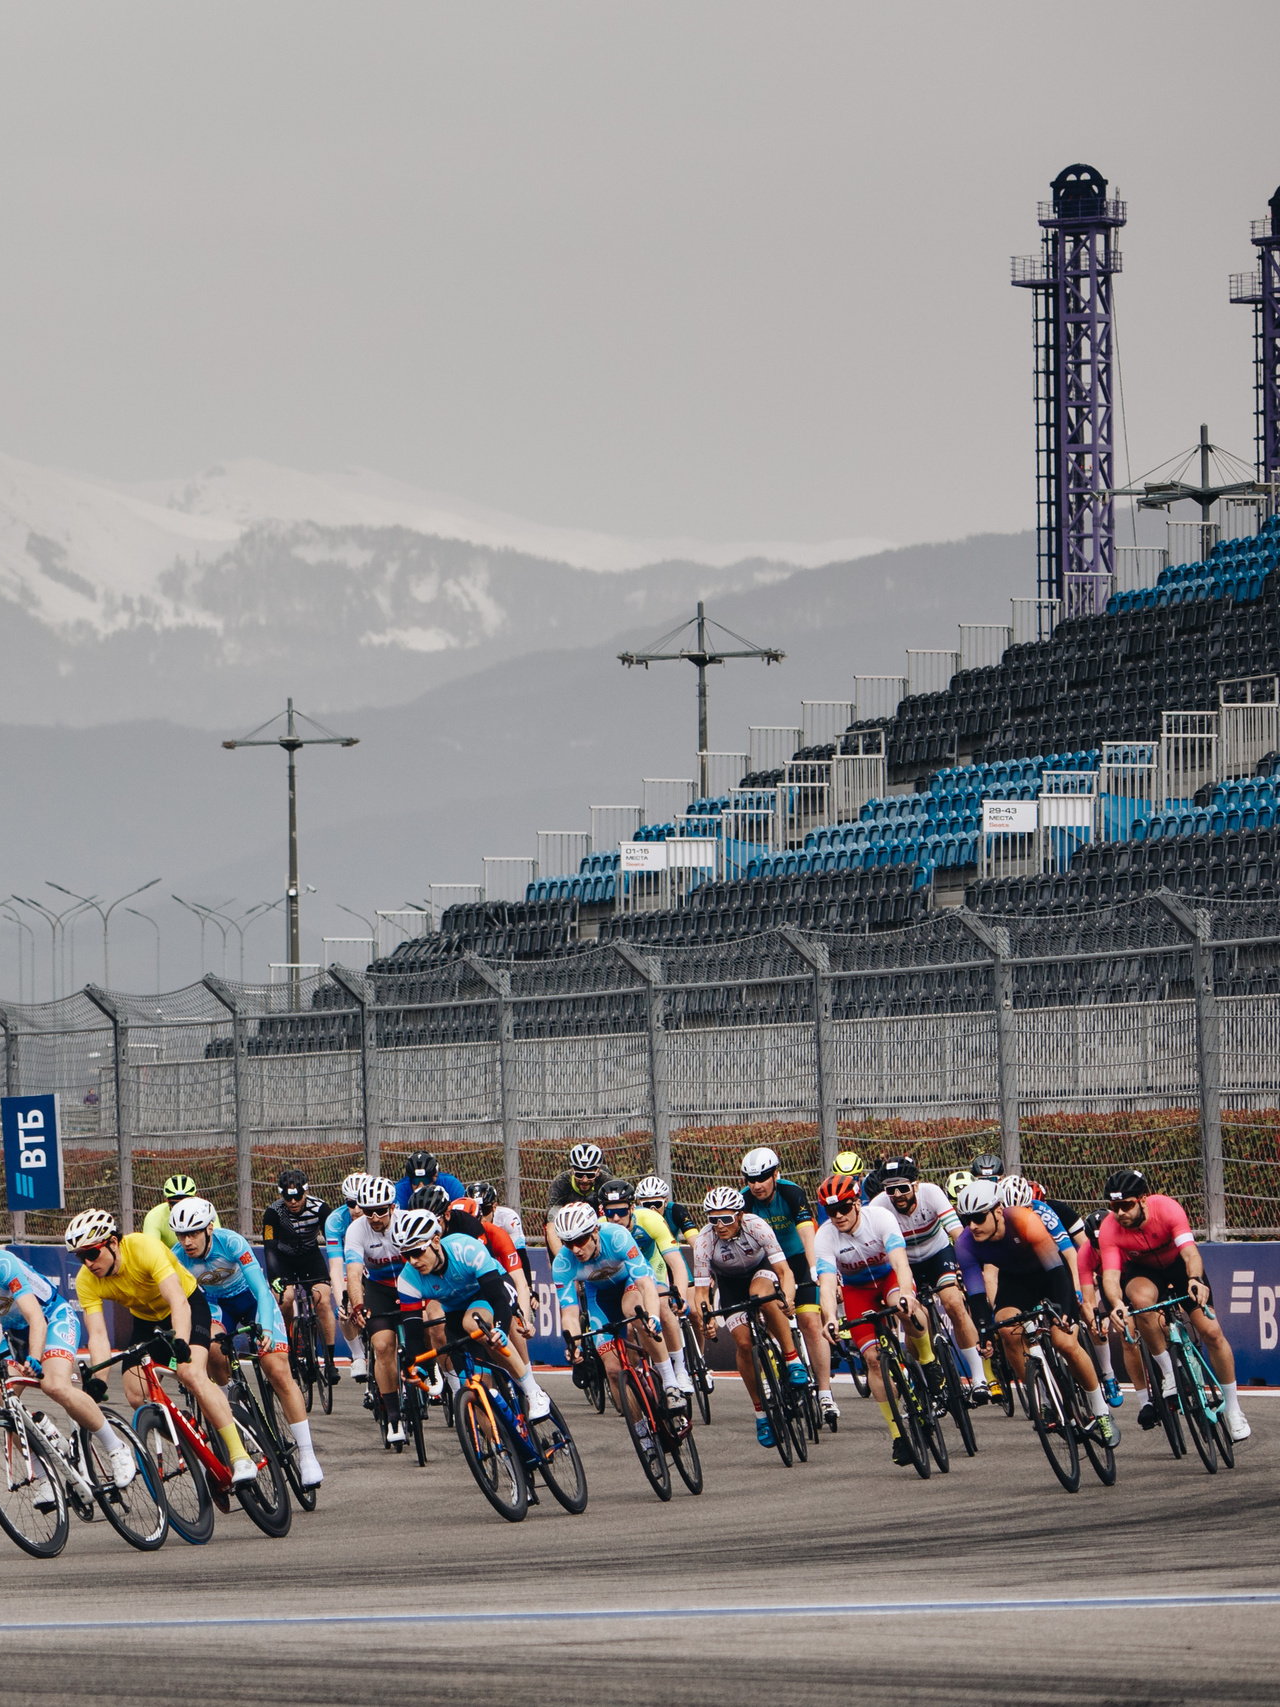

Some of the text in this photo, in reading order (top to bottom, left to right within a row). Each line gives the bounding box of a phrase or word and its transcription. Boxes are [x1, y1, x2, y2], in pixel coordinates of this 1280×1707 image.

[17, 1109, 47, 1169] ВТБ
[1038, 1205, 1059, 1220] BLACK
[367, 1255, 403, 1265] RUSSI
[840, 1252, 886, 1270] RUSSIA
